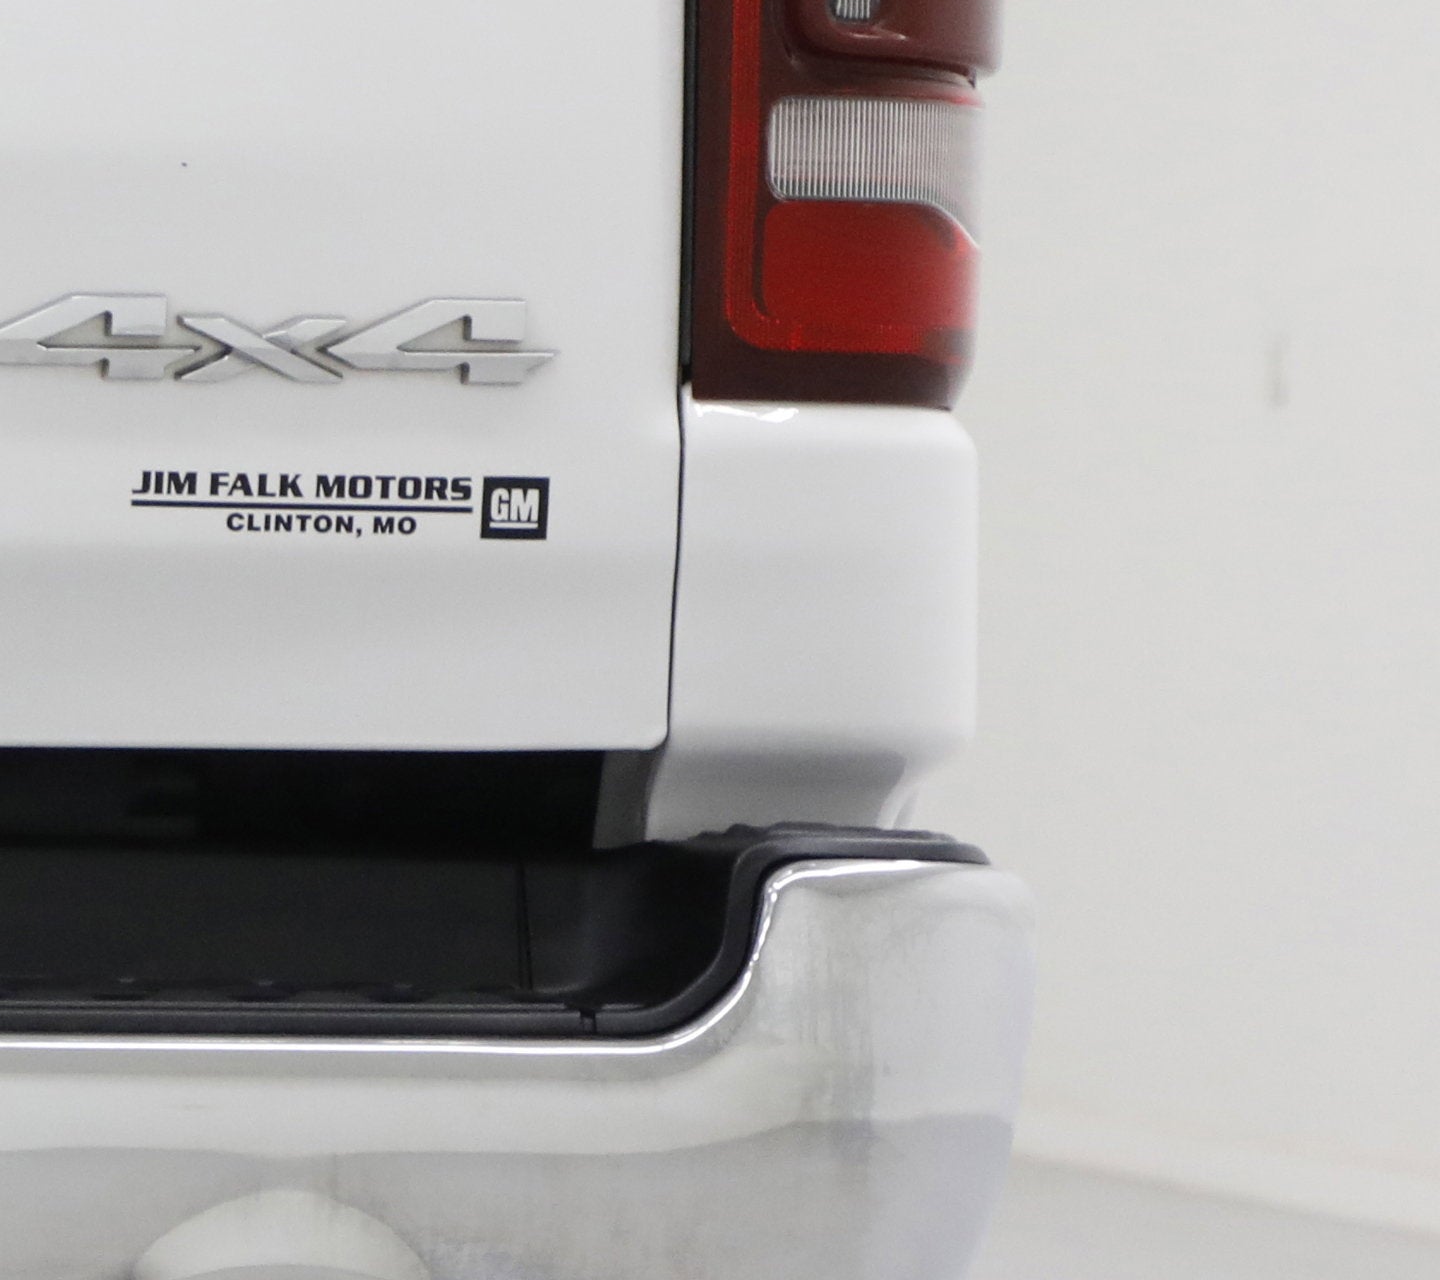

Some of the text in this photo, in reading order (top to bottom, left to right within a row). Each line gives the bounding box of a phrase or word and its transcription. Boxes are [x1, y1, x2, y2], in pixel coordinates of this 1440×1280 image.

[132, 471, 472, 501] JIM FALK MOTORS
[490, 487, 539, 523] GM
[226, 513, 417, 538] CLINTON, MO
